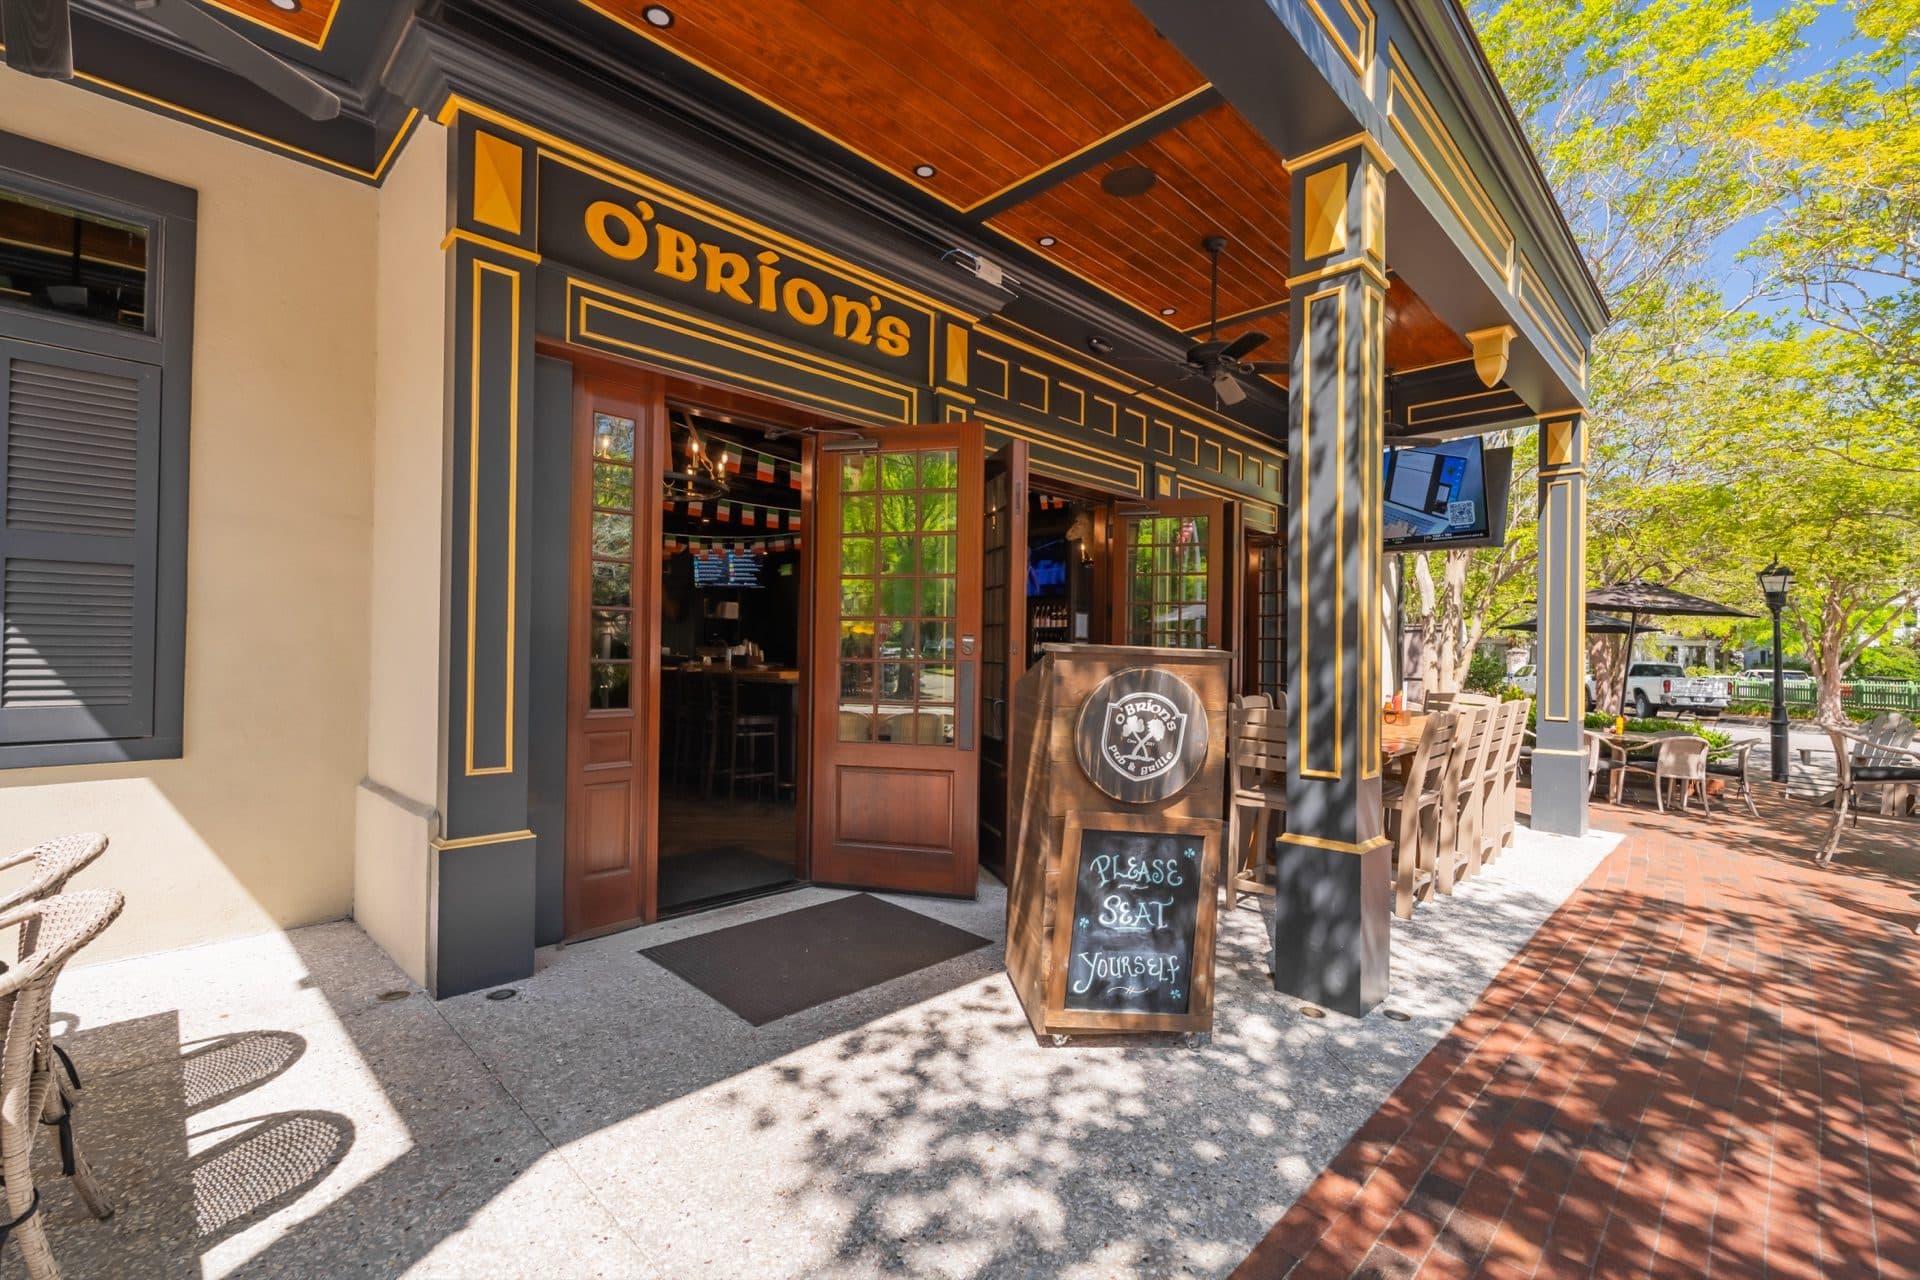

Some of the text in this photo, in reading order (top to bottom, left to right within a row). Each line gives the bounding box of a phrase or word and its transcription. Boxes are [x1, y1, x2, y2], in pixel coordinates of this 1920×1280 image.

[1090, 854, 1183, 888] PLEASE
[1098, 894, 1174, 929] SEAT
[1073, 951, 1180, 994] YOURSELF
